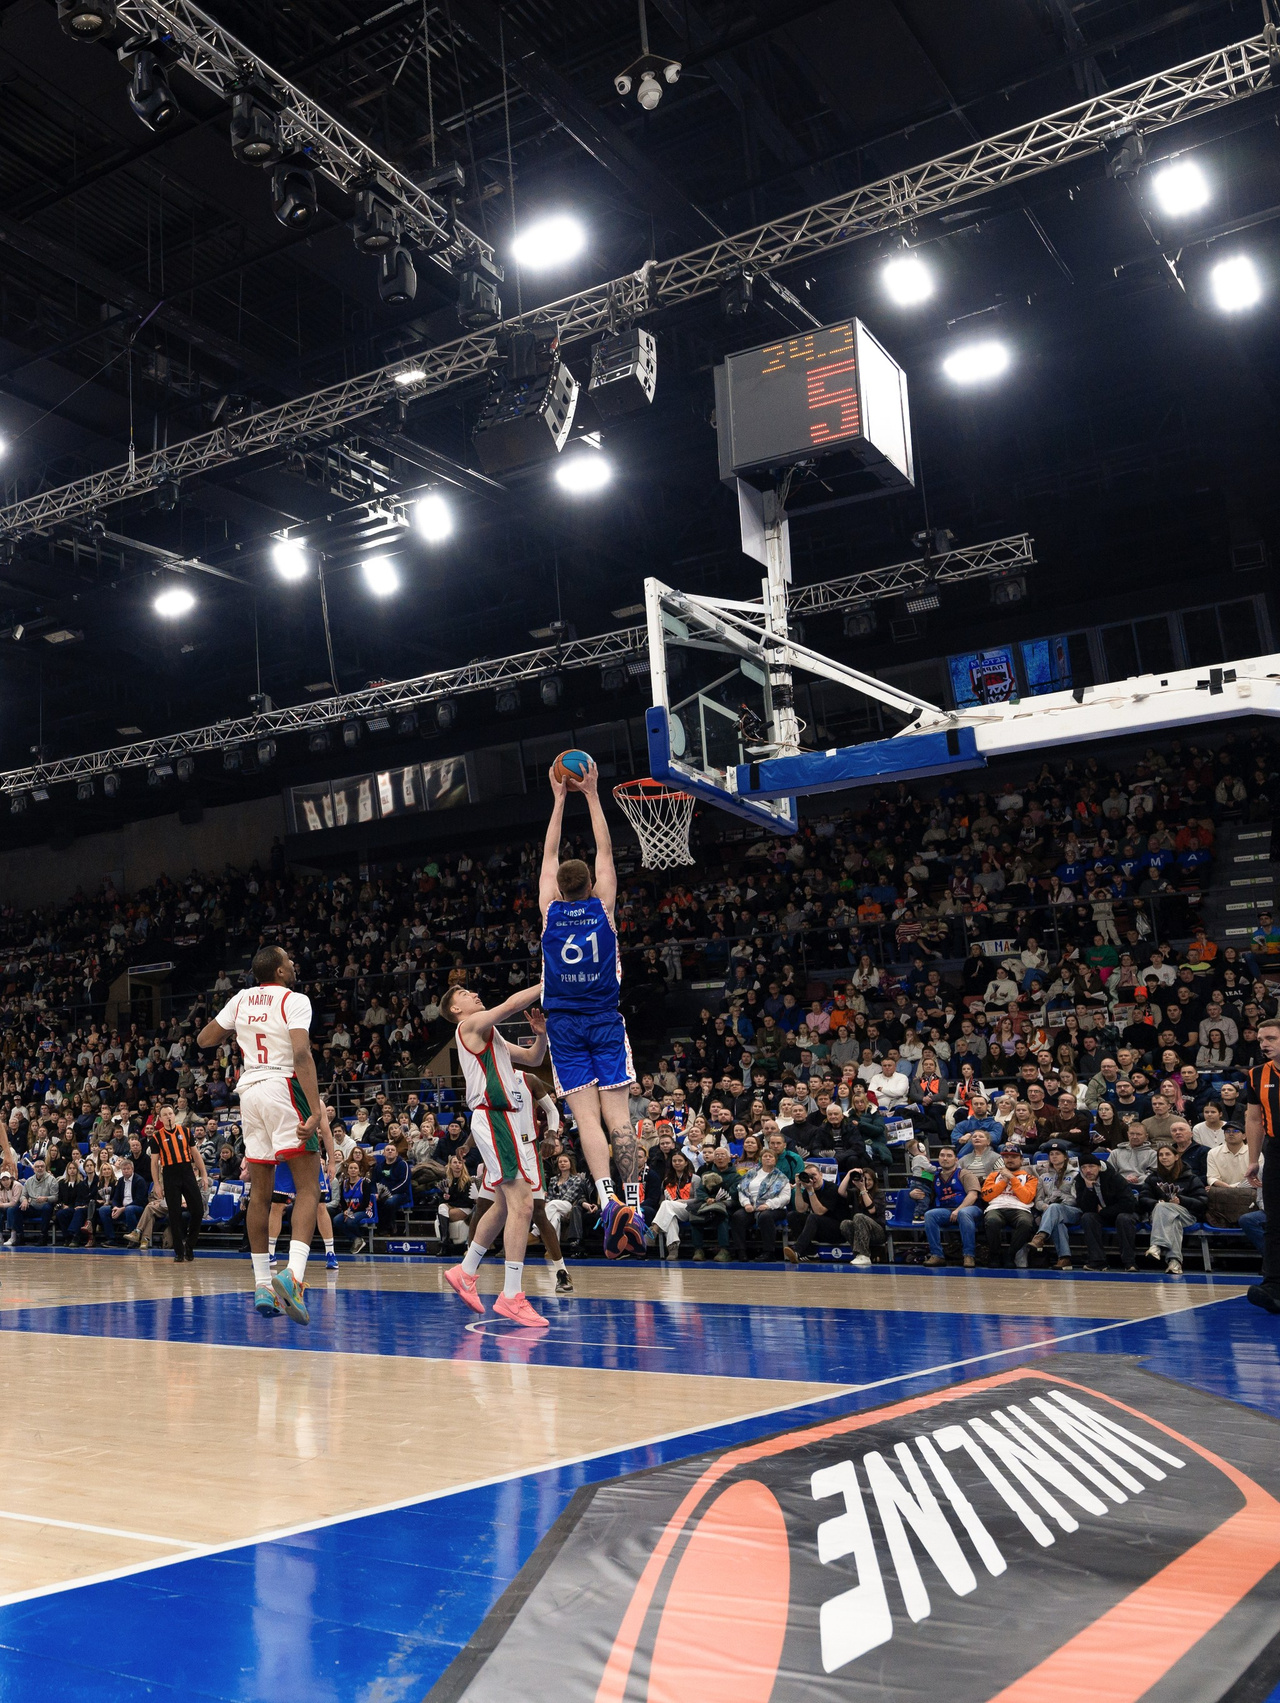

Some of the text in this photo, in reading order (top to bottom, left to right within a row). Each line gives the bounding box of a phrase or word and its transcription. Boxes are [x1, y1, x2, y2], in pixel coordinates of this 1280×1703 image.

[806, 359, 859, 443] 5
[556, 918, 598, 927] БЕТСИТИ
[561, 931, 600, 965] 61
[561, 973, 578, 983] PERM
[248, 995, 274, 1006] MARTIN
[255, 1034, 269, 1065] 5
[811, 1389, 1187, 1674] WINLINE
